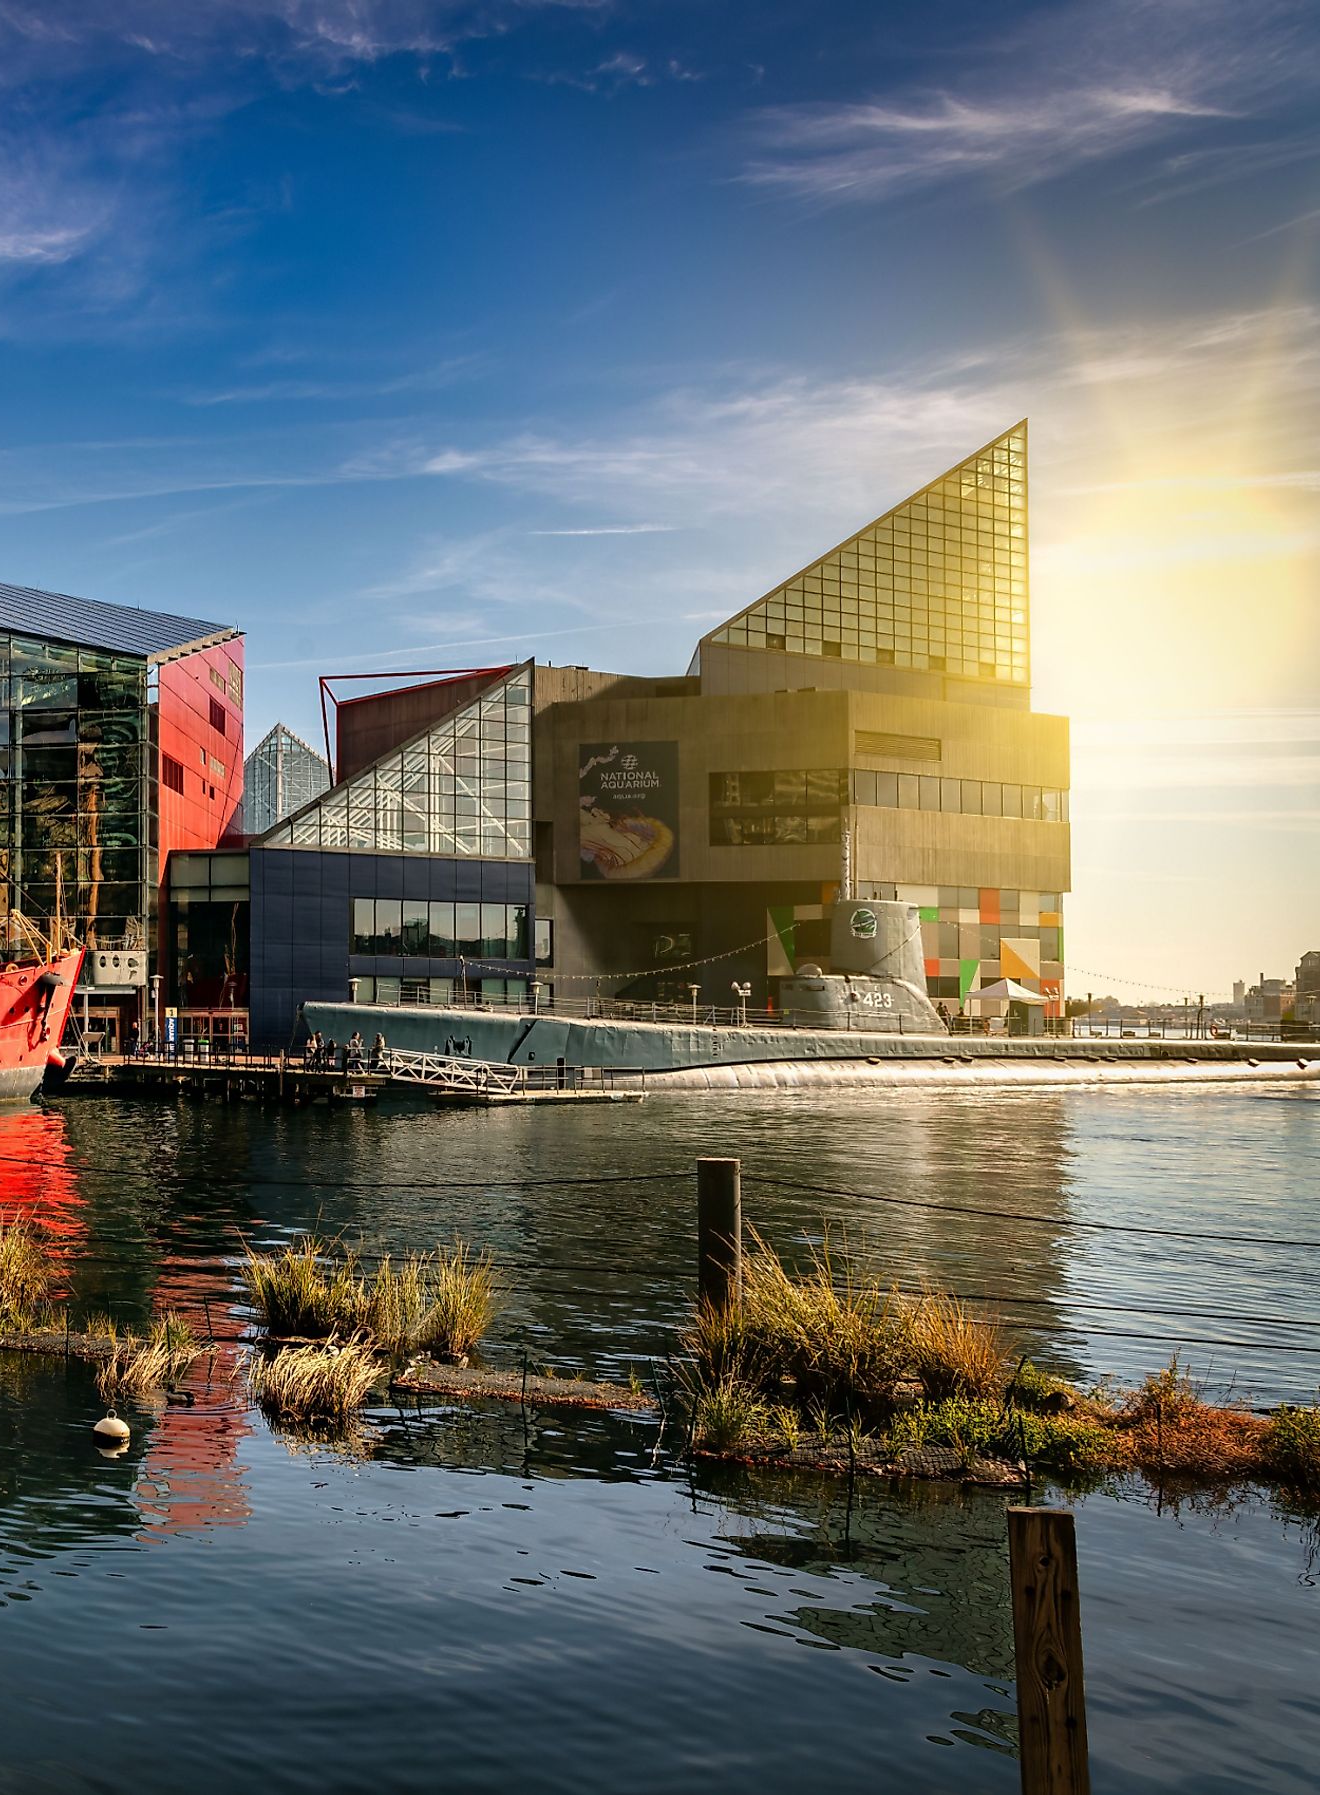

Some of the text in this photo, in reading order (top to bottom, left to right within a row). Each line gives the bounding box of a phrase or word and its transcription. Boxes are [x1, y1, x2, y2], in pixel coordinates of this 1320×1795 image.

[600, 771, 659, 782] NATIONAL
[600, 779, 660, 790] AQUARIUM
[862, 992, 892, 1008] 423
